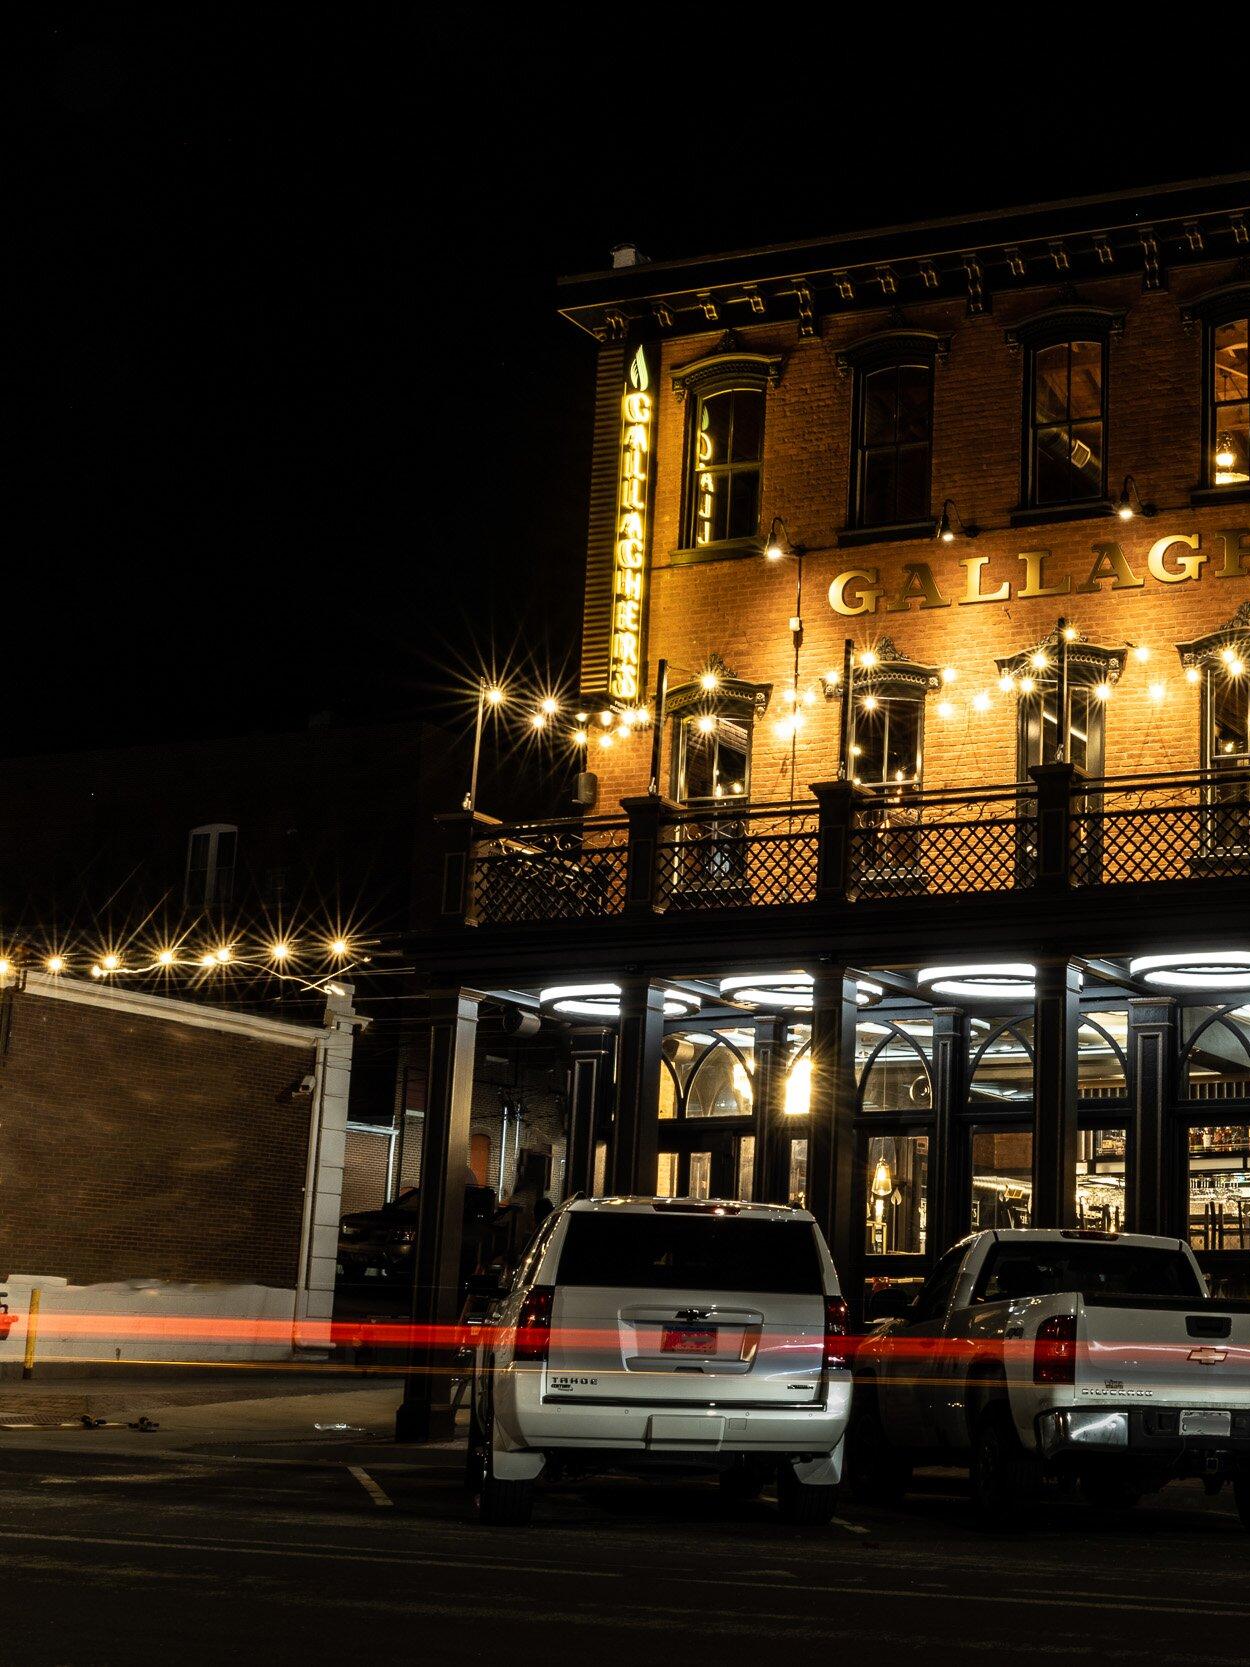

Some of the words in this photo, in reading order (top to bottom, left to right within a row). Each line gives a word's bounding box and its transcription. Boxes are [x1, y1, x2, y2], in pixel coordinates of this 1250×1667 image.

[608, 392, 651, 698] GALLAGHERS
[552, 1377, 598, 1385] TAHOE
[1082, 1388, 1153, 1396] SILVERADO
